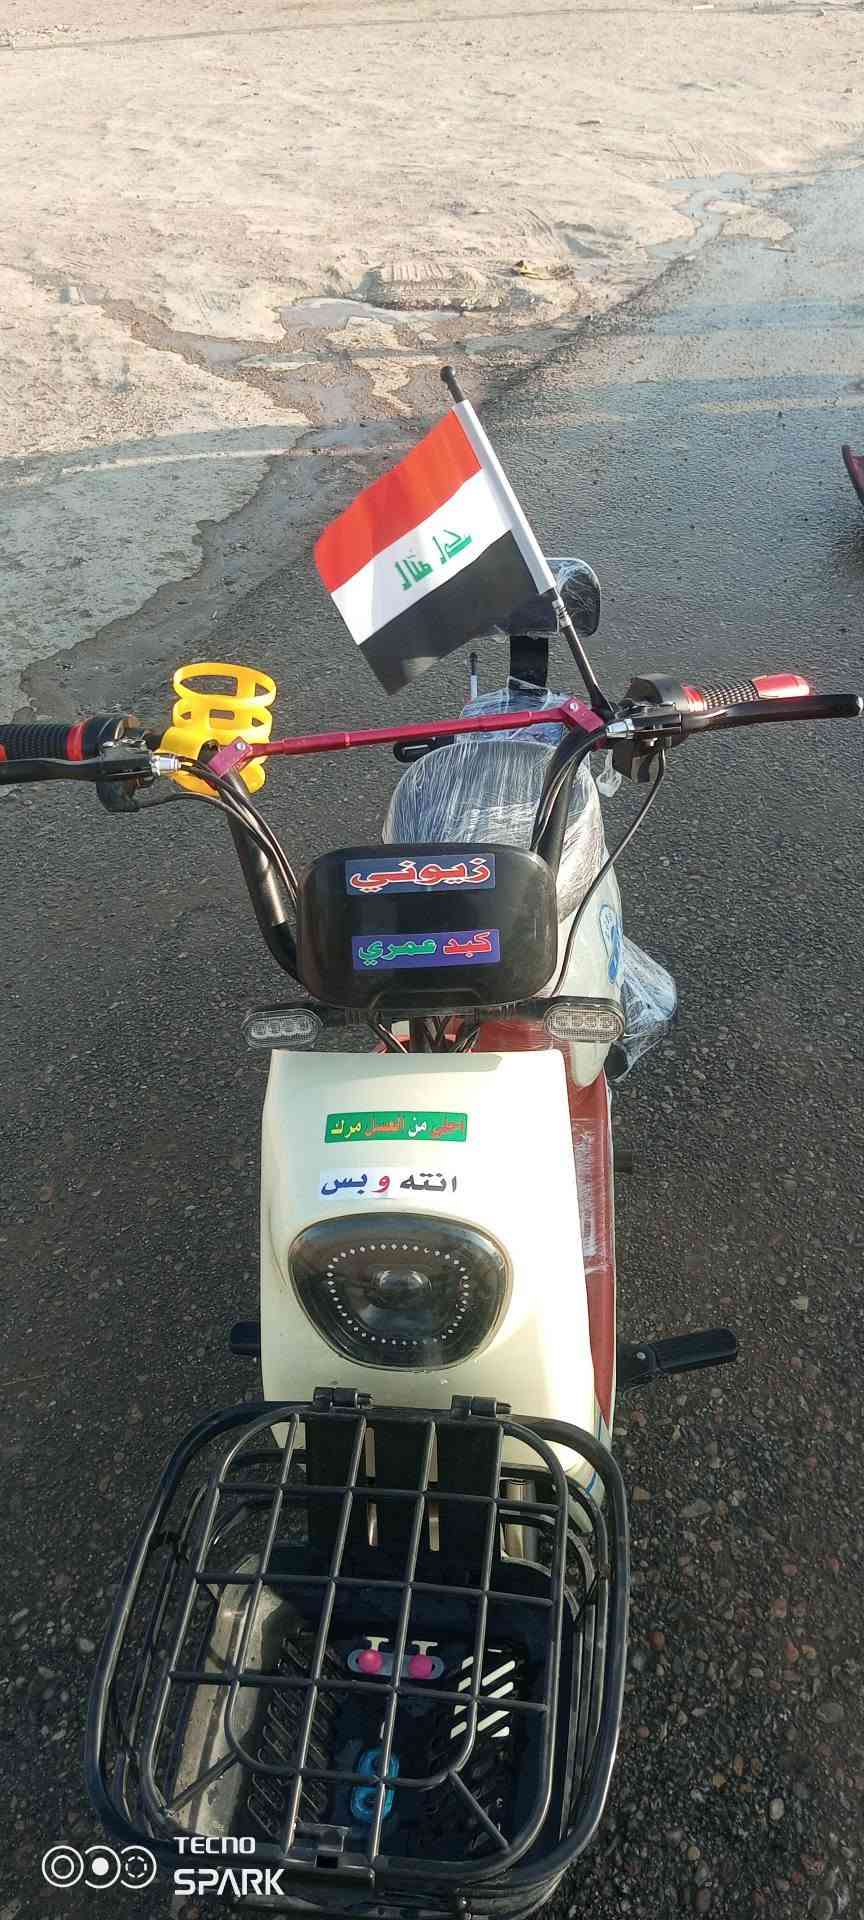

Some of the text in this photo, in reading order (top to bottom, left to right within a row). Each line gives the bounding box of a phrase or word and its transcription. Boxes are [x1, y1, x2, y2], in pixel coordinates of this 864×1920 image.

[350, 858, 491, 893] زيوني
[358, 931, 492, 966] كبد عمري
[408, 1117, 427, 1137] من
[320, 1172, 457, 1195] انته و بس
